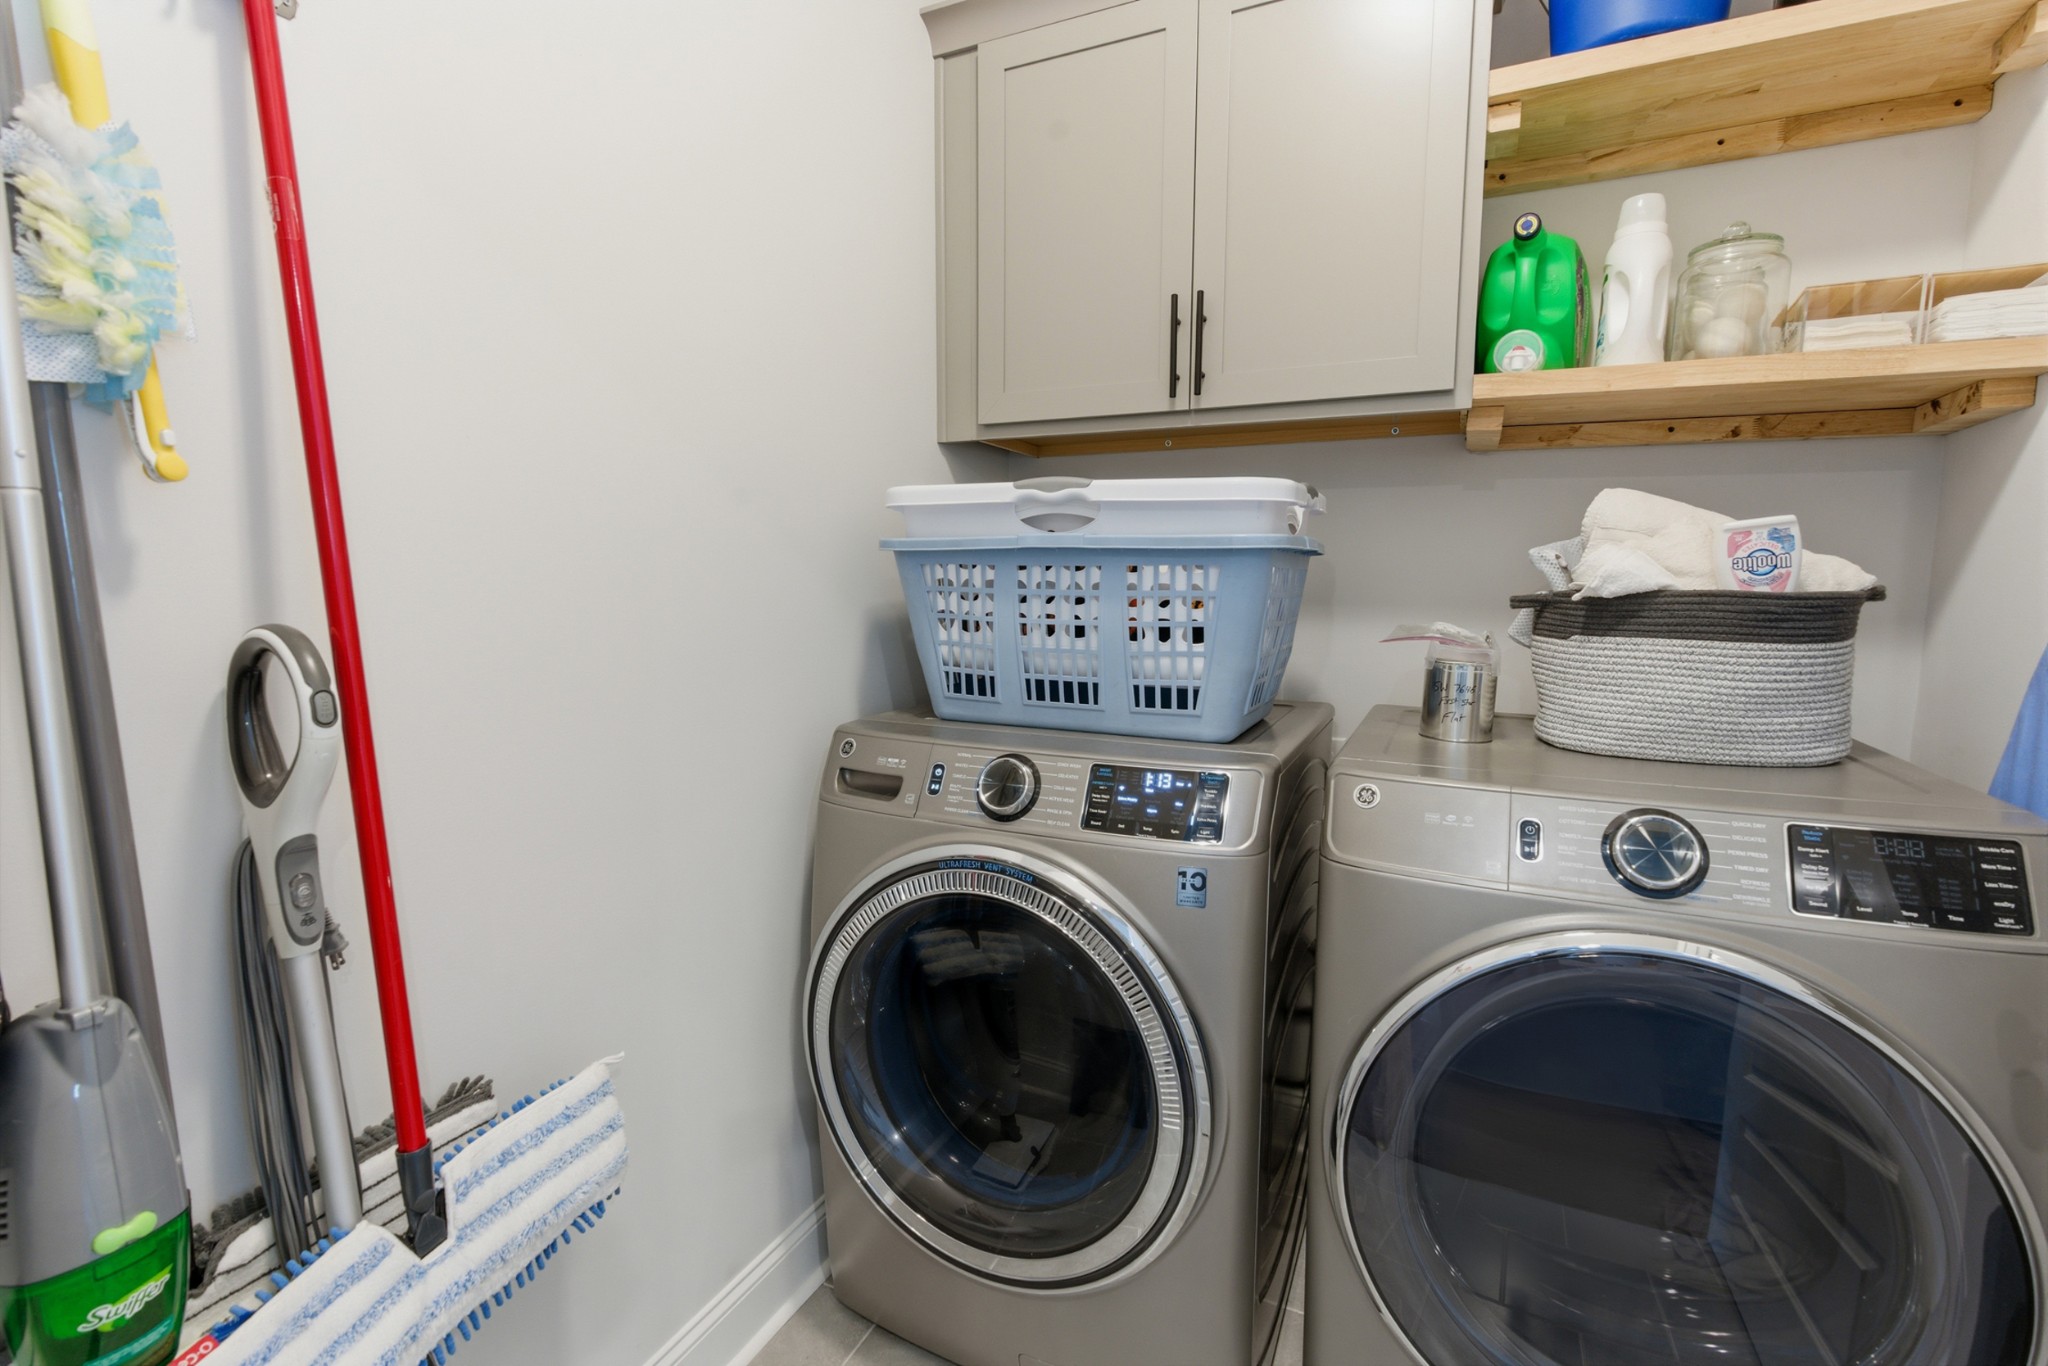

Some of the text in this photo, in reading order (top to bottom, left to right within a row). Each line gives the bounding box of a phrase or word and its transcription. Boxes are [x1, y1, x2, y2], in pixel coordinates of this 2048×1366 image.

[938, 861, 1033, 883] ULTRAFRESH VENT SYSTEM
[77, 1273, 171, 1332] Swiffer
